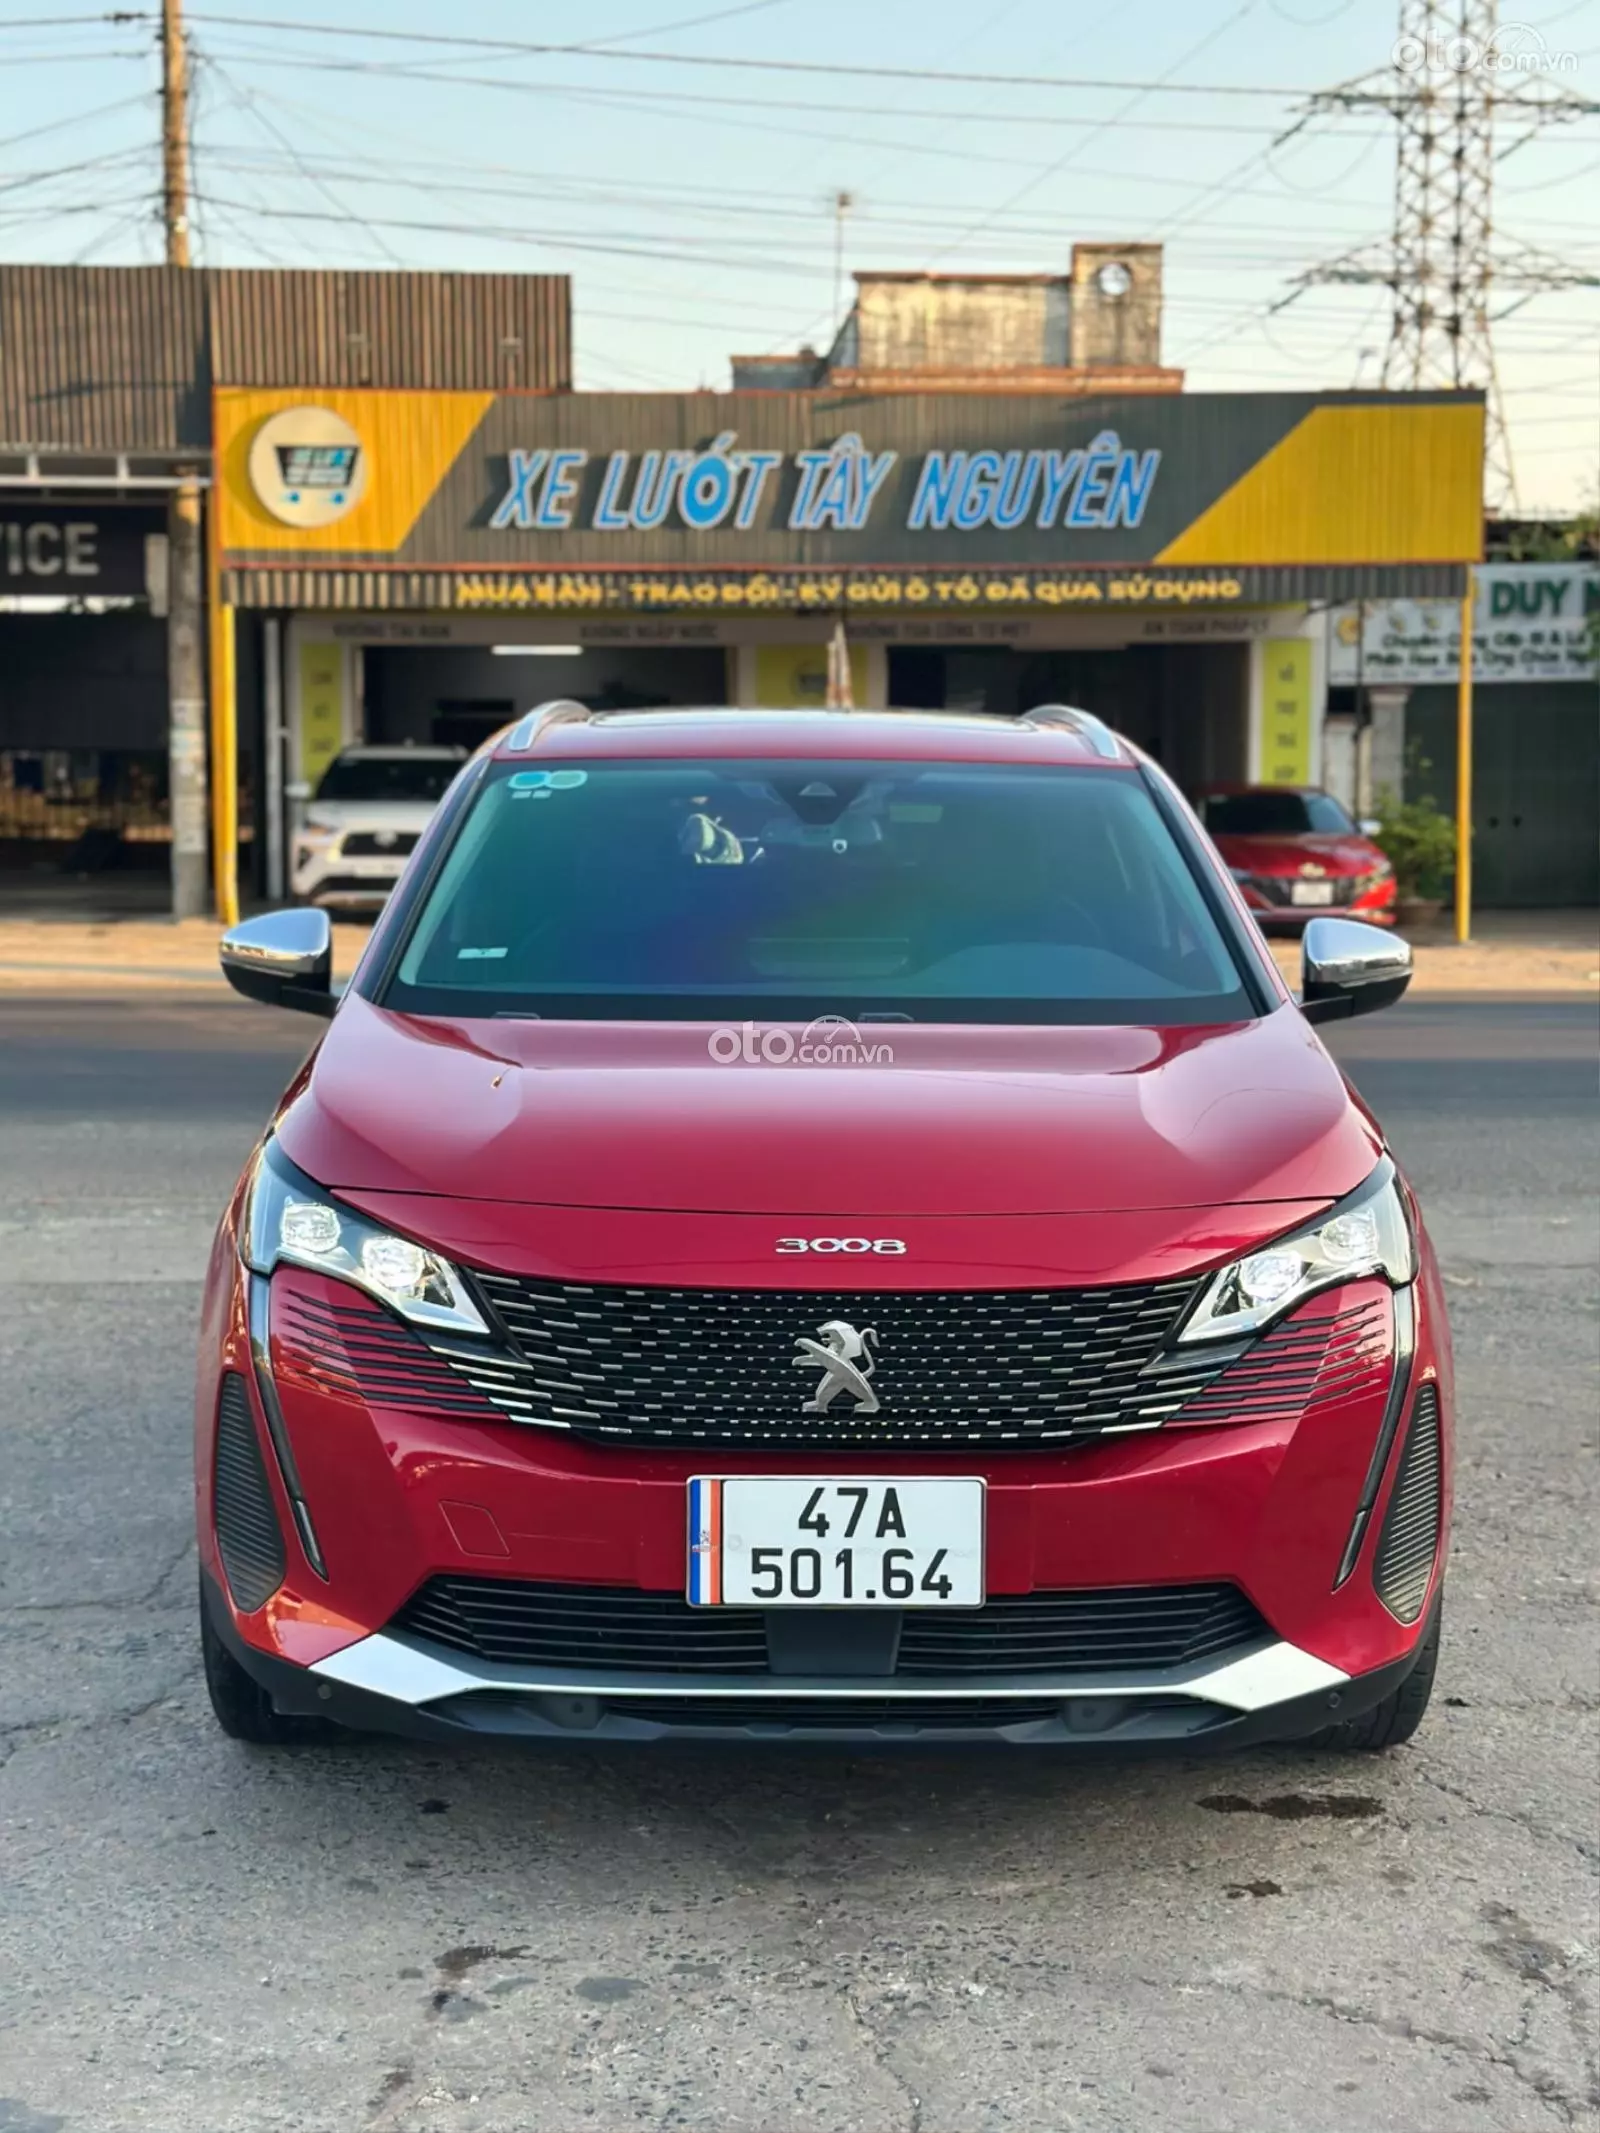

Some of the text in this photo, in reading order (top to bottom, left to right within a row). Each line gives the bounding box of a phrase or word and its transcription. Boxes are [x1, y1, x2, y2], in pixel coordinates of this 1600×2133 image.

[488, 429, 1162, 530] XE LƯỚT TÂY NGUYÊN
[0, 522, 100, 576] ICE
[1034, 580, 1103, 604] QUA
[1490, 579, 1570, 618] DUY
[775, 1237, 907, 1254] 3008
[798, 1487, 906, 1538] 47A
[751, 1547, 952, 1599] 501.64
